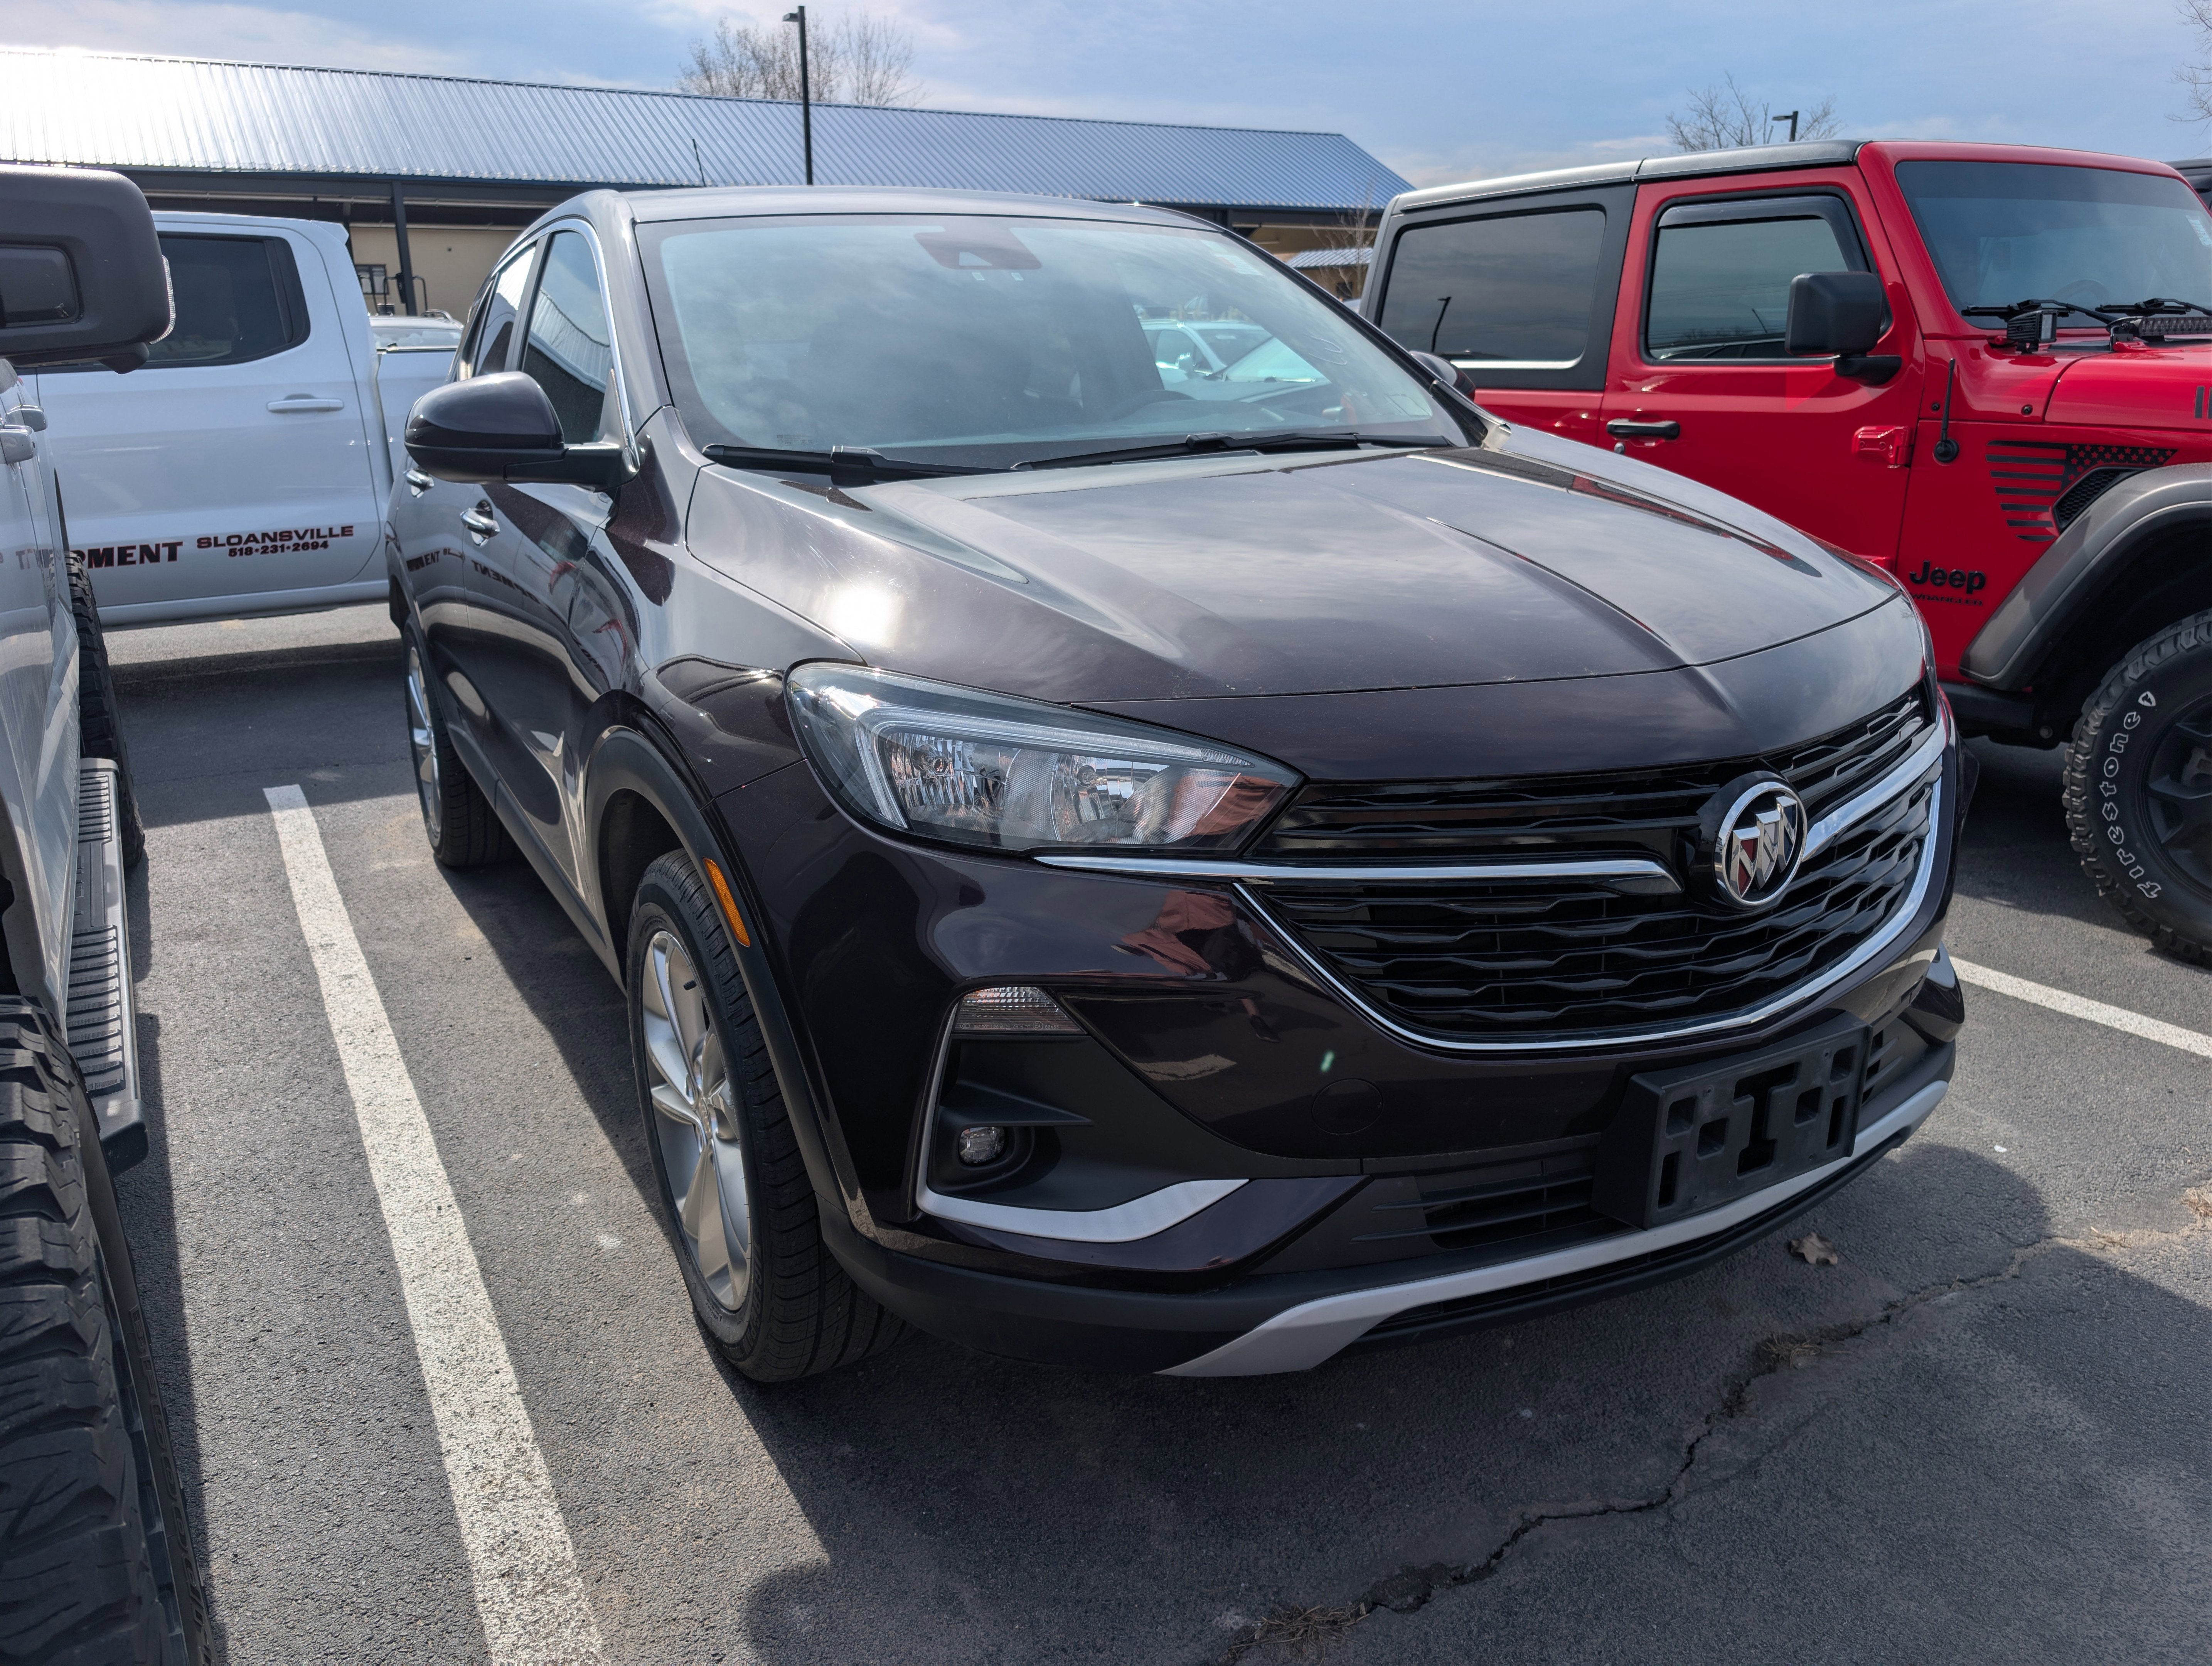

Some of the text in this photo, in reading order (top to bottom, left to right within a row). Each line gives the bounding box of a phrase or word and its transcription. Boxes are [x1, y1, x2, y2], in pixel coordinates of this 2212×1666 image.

[197, 526, 354, 549] SLOANSVILLE
[1910, 560, 1986, 594] Jeep
[1911, 594, 1983, 606] WRANGLER
[2099, 712, 2161, 898] Firestone
